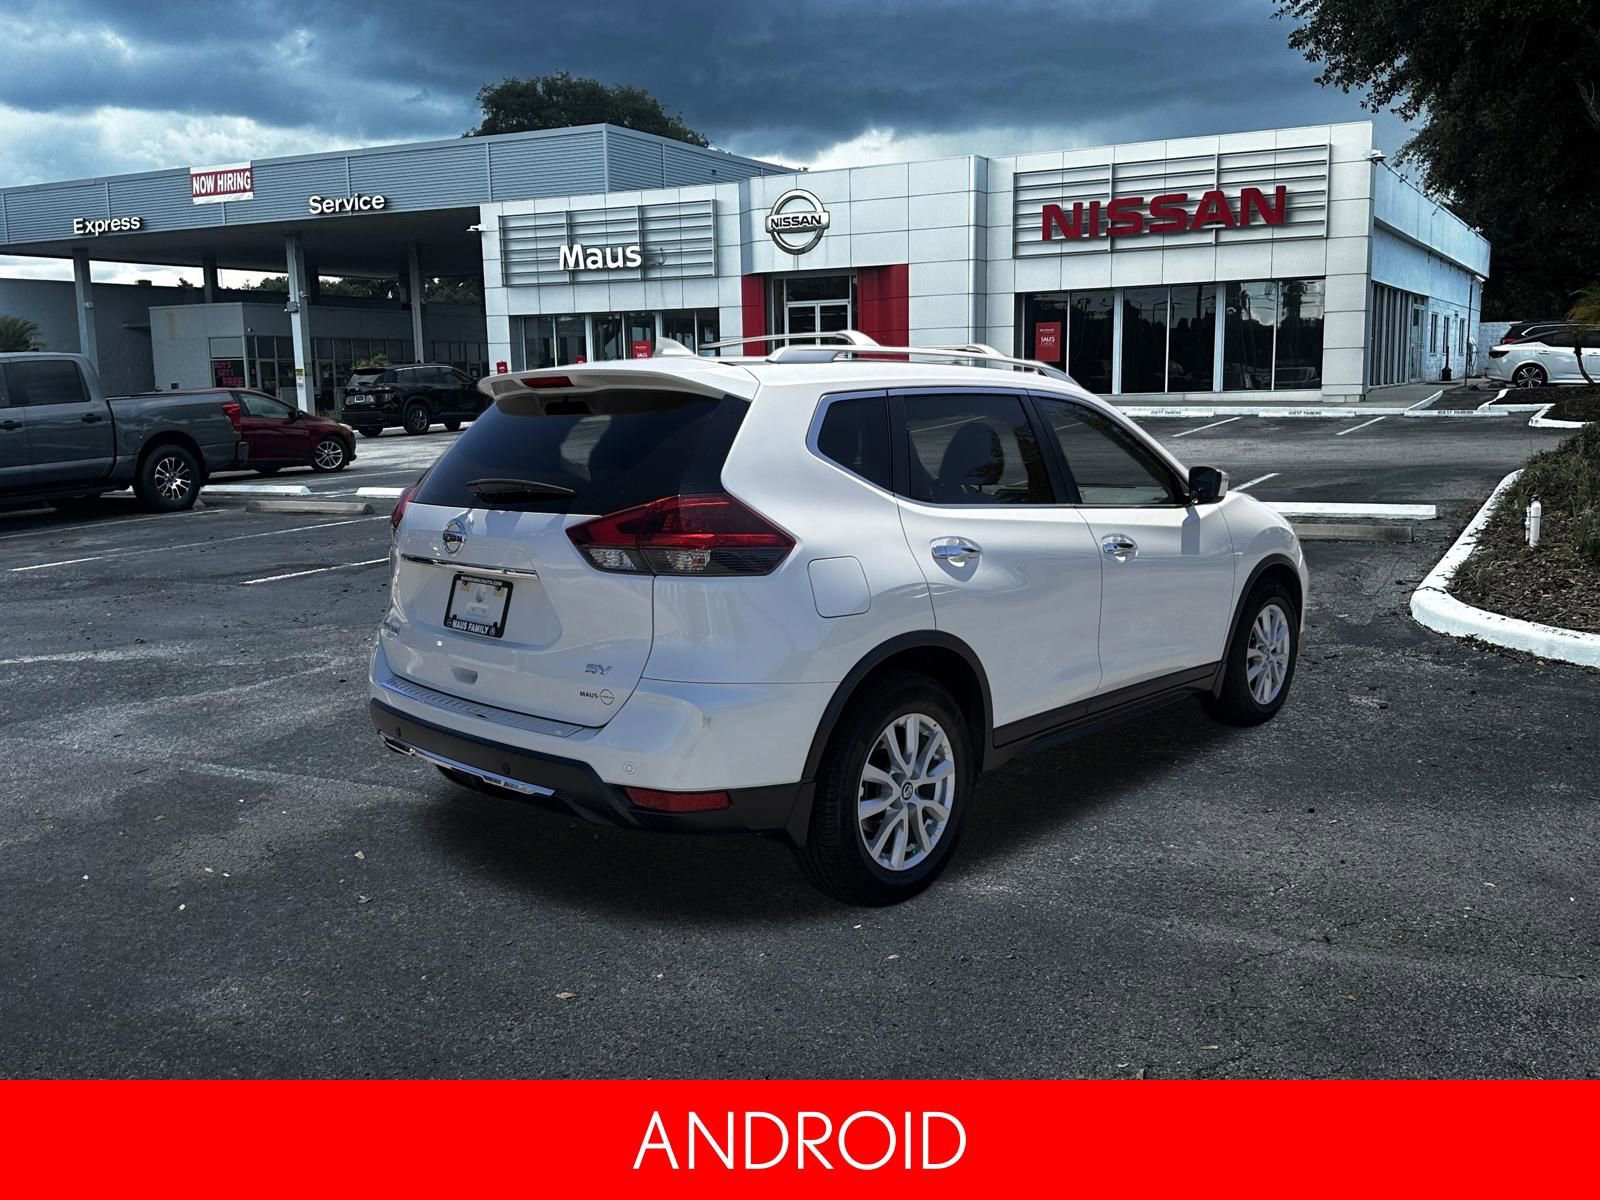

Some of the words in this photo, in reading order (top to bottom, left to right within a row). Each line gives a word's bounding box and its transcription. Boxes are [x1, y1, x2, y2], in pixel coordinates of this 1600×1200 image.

[192, 174, 215, 194] NOW
[216, 171, 251, 192] HIRING
[309, 193, 385, 214] Service
[1041, 185, 1287, 241] NISSAN
[73, 216, 141, 237] Express
[770, 215, 822, 229] NISSAN
[559, 243, 642, 271] Maus
[452, 620, 468, 632] MAUS
[467, 623, 490, 635] FAMILY
[585, 663, 614, 675] SV
[580, 691, 598, 699] MAUS
